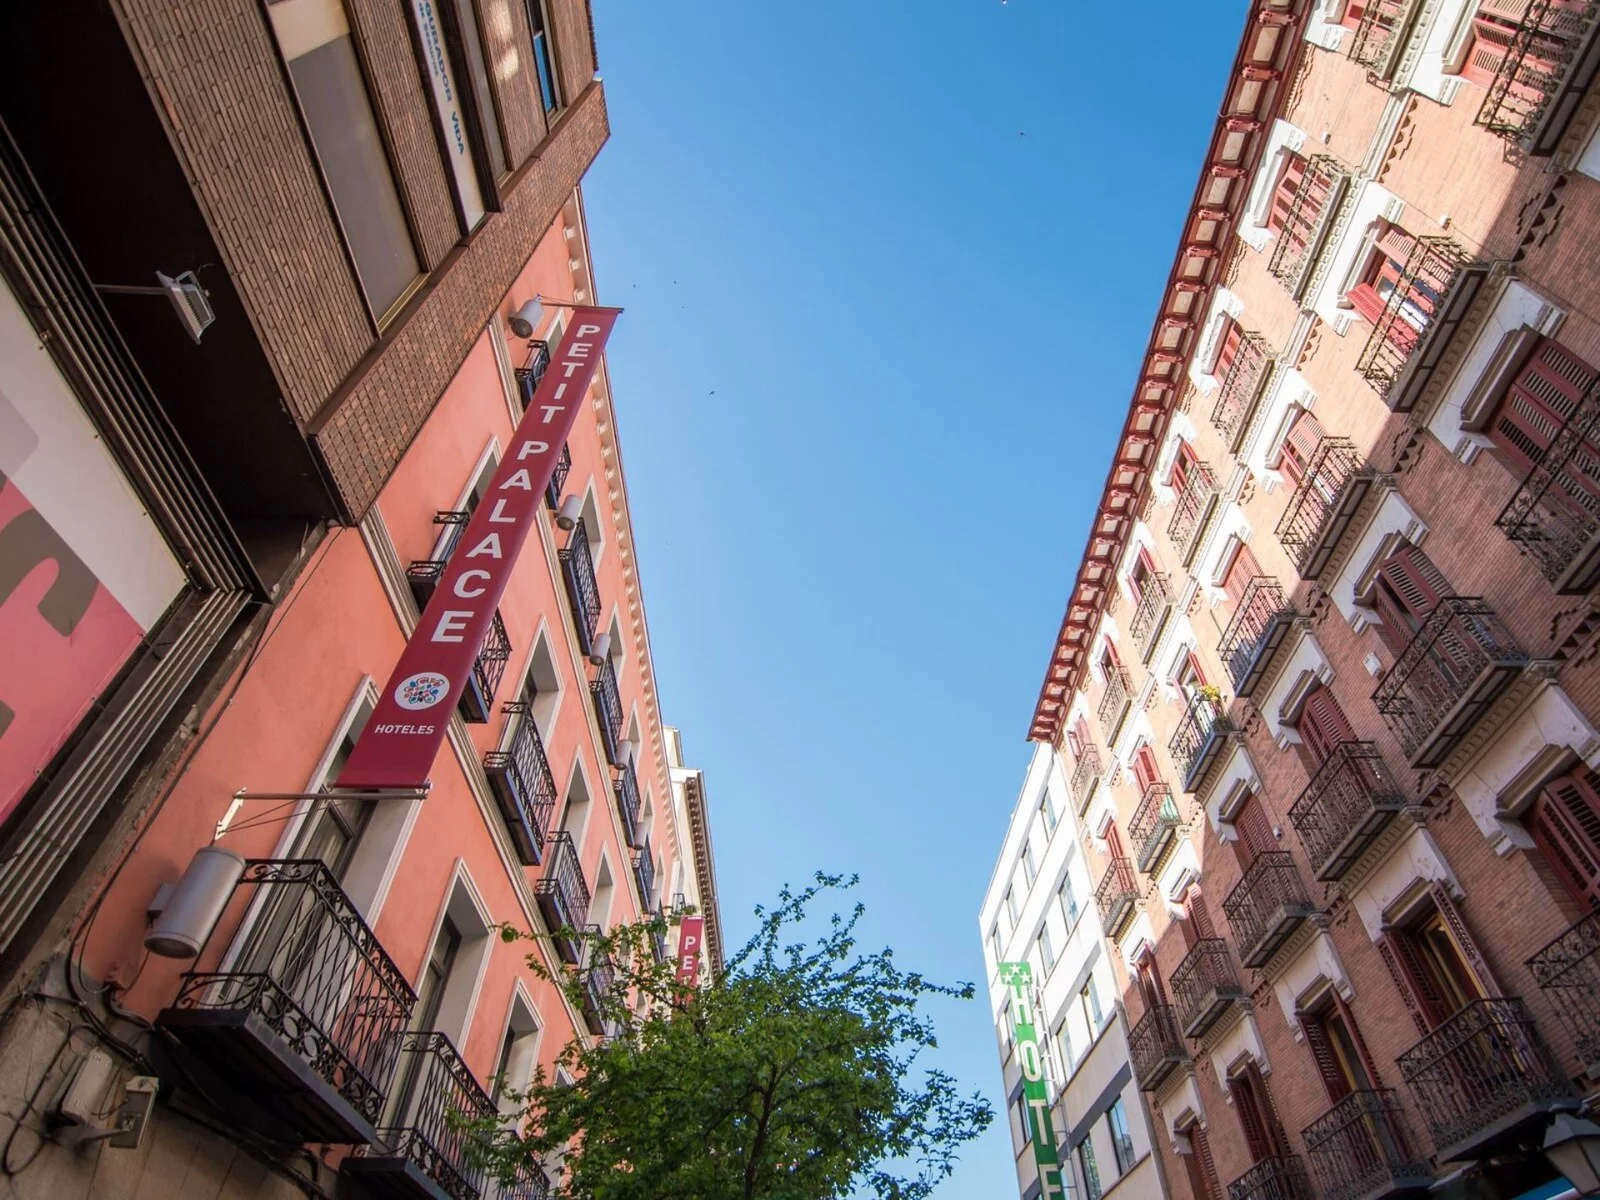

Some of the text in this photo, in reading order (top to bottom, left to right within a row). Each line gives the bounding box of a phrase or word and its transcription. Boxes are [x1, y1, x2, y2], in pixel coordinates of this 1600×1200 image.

[424, 0, 464, 155] GURADOR VIDA
[431, 324, 600, 643] PETIT PALACE
[374, 724, 435, 735] HOTELES
